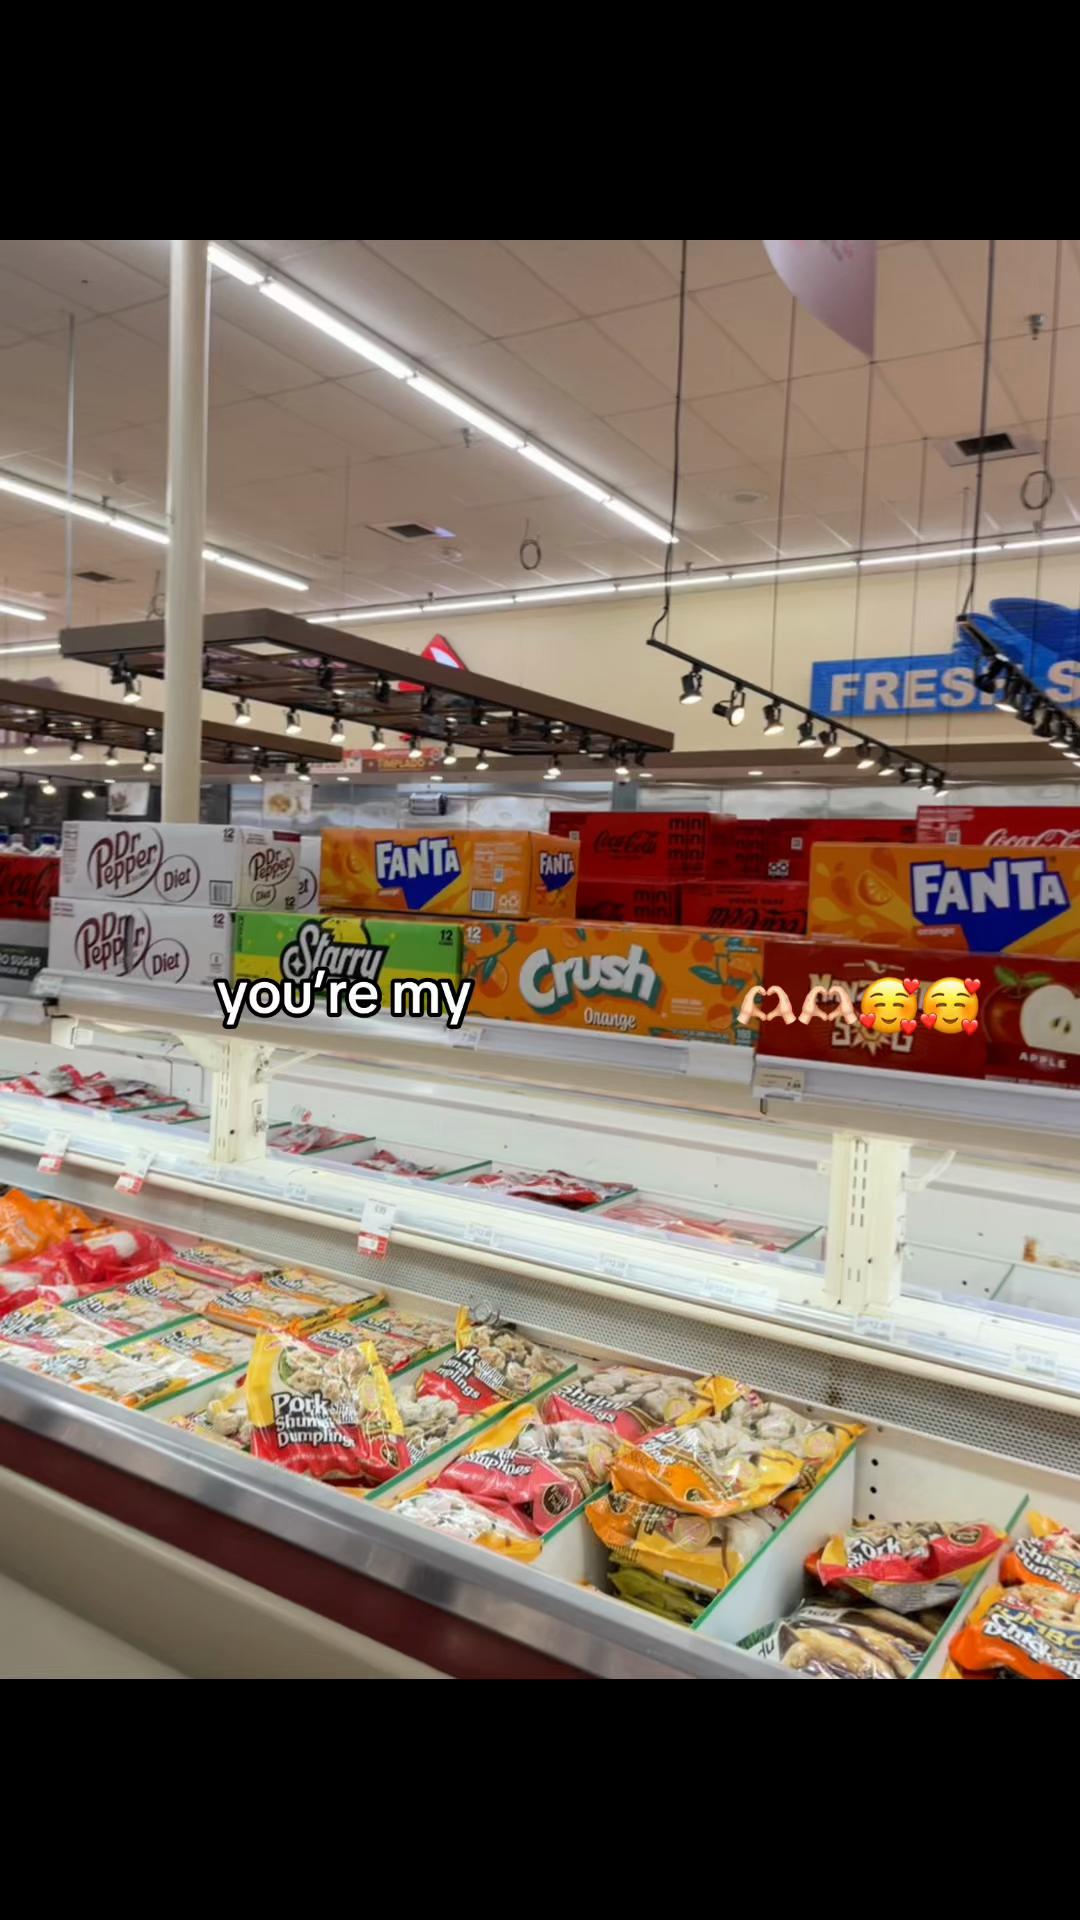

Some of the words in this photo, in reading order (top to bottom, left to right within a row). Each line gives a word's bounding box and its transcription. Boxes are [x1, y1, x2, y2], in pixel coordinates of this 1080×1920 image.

[830, 664, 1022, 712] FRES
[115, 830, 141, 861] Dr
[223, 827, 235, 839] 12
[88, 837, 158, 890] Pepper
[375, 836, 460, 880] FANTA
[540, 852, 575, 876] FANTA
[164, 868, 192, 892] Diet
[912, 859, 1067, 915] FANTA
[212, 913, 224, 925] 12
[76, 917, 145, 971] Peppr
[440, 930, 454, 942] 12
[466, 926, 482, 940] 12
[152, 953, 181, 975] Diet
[283, 923, 384, 982] Starry
[519, 943, 657, 1008] Crush
[584, 1007, 637, 1031] Orange
[1019, 1051, 1067, 1070] APPLE
[272, 1392, 329, 1418] Pork
